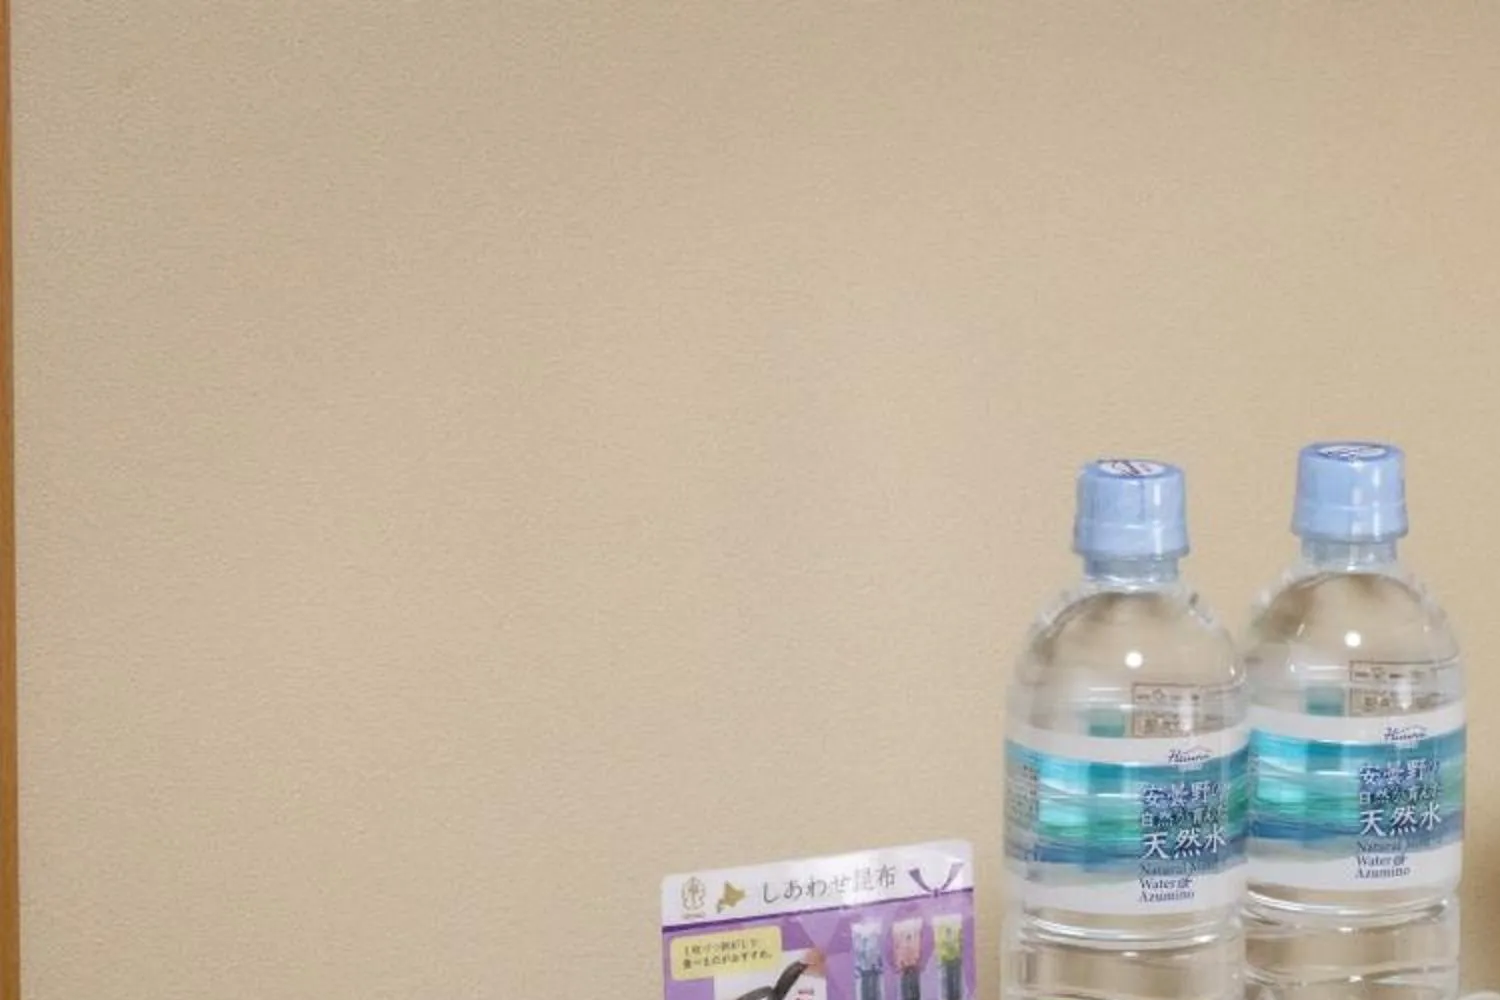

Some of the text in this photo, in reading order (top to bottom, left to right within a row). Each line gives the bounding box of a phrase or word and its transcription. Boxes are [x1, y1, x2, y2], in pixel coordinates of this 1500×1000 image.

[1360, 805, 1442, 838] 天然水
[1141, 825, 1227, 860] 天然水
[1357, 840, 1402, 854] Natural
[1139, 861, 1186, 876] Natural
[1357, 856, 1391, 867] Water
[1355, 867, 1410, 879] Azumino
[762, 865, 896, 904] しあわせ昆布
[1140, 878, 1176, 890] Water
[1139, 889, 1194, 904] Azumino
